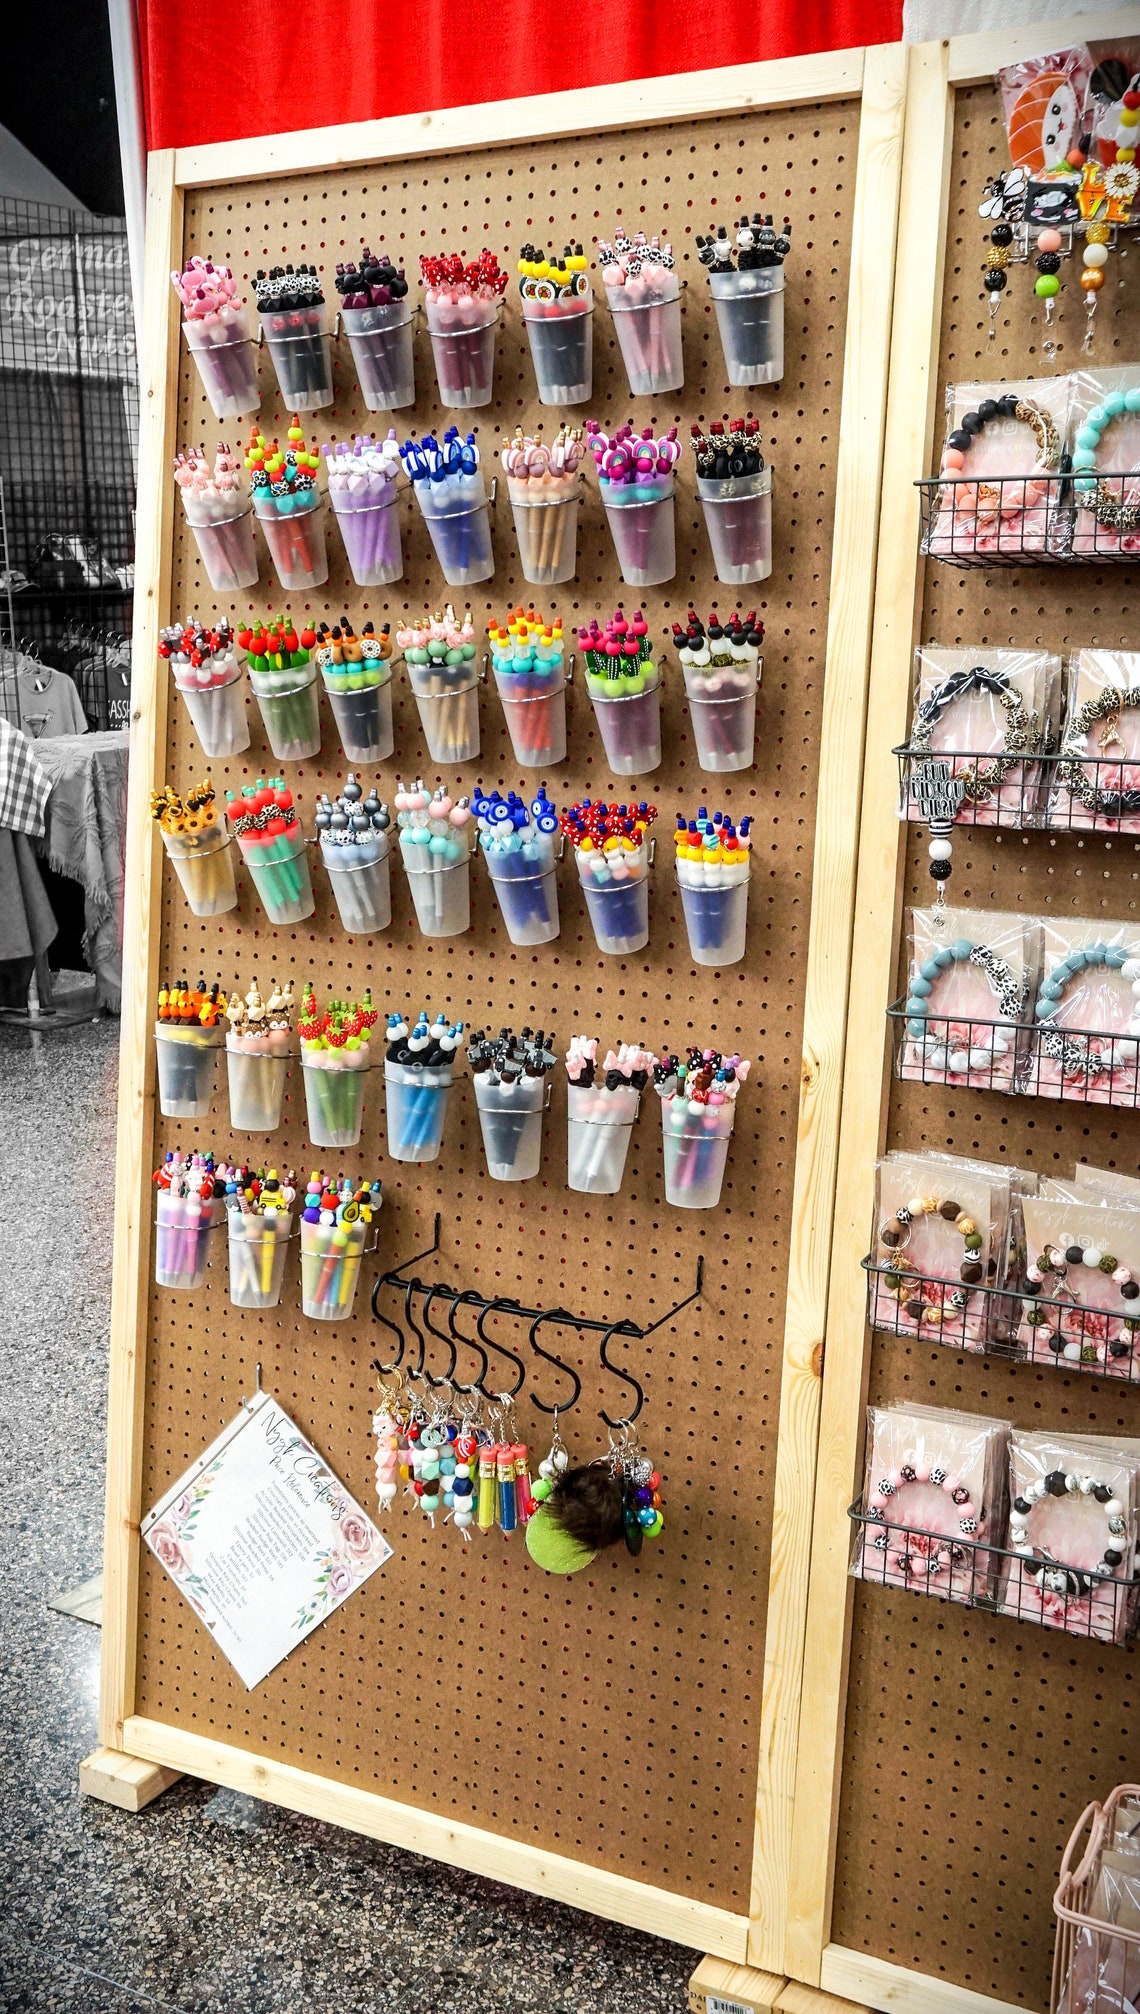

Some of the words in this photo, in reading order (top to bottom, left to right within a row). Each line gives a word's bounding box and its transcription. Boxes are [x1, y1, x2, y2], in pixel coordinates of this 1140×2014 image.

[911, 781, 934, 799] DID
[936, 782, 964, 799] YOU
[269, 1455, 288, 1478] Price
[272, 1505, 287, 1524] Beaded
[297, 1527, 313, 1547] marked
[304, 1524, 320, 1544] marked
